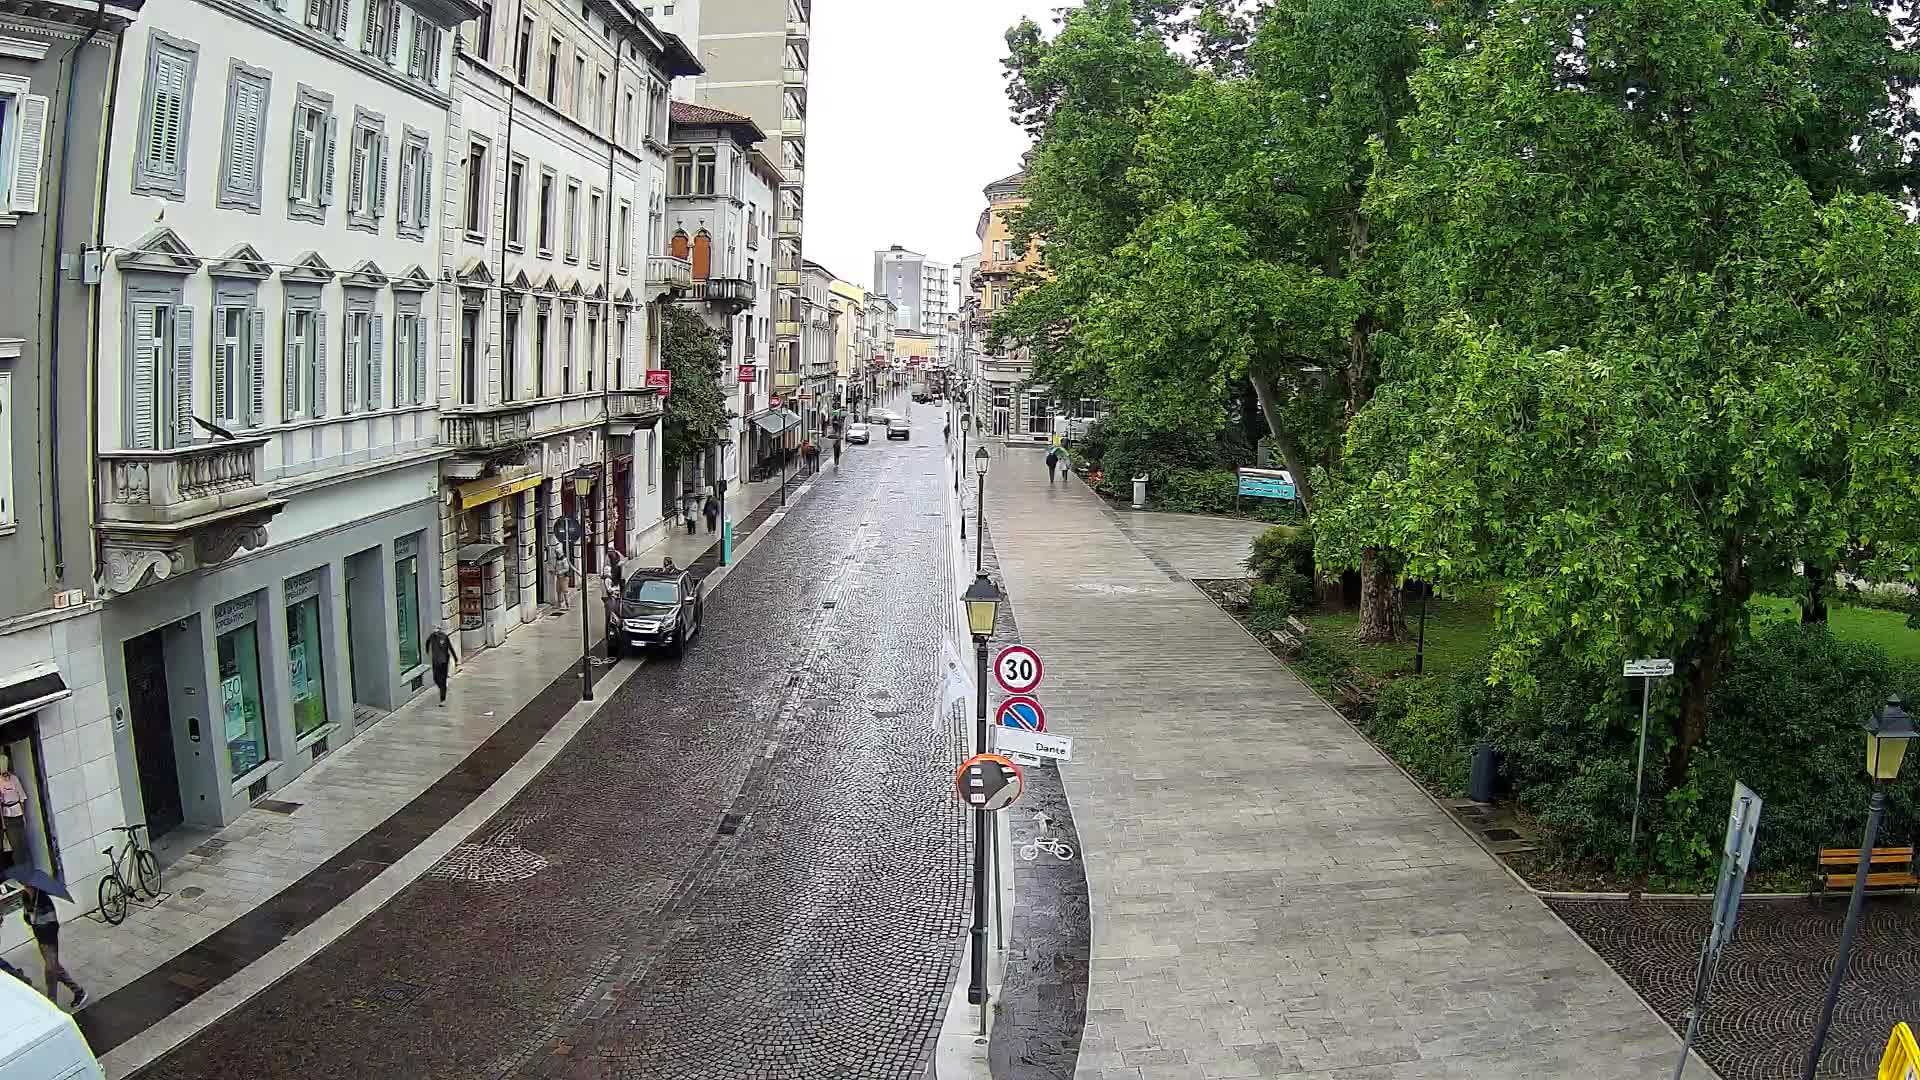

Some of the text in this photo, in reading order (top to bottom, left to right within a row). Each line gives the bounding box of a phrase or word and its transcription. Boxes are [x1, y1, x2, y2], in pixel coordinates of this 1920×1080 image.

[1005, 658, 1032, 681] 30
[222, 678, 241, 701] 130
[1036, 742, 1066, 755] Dante
